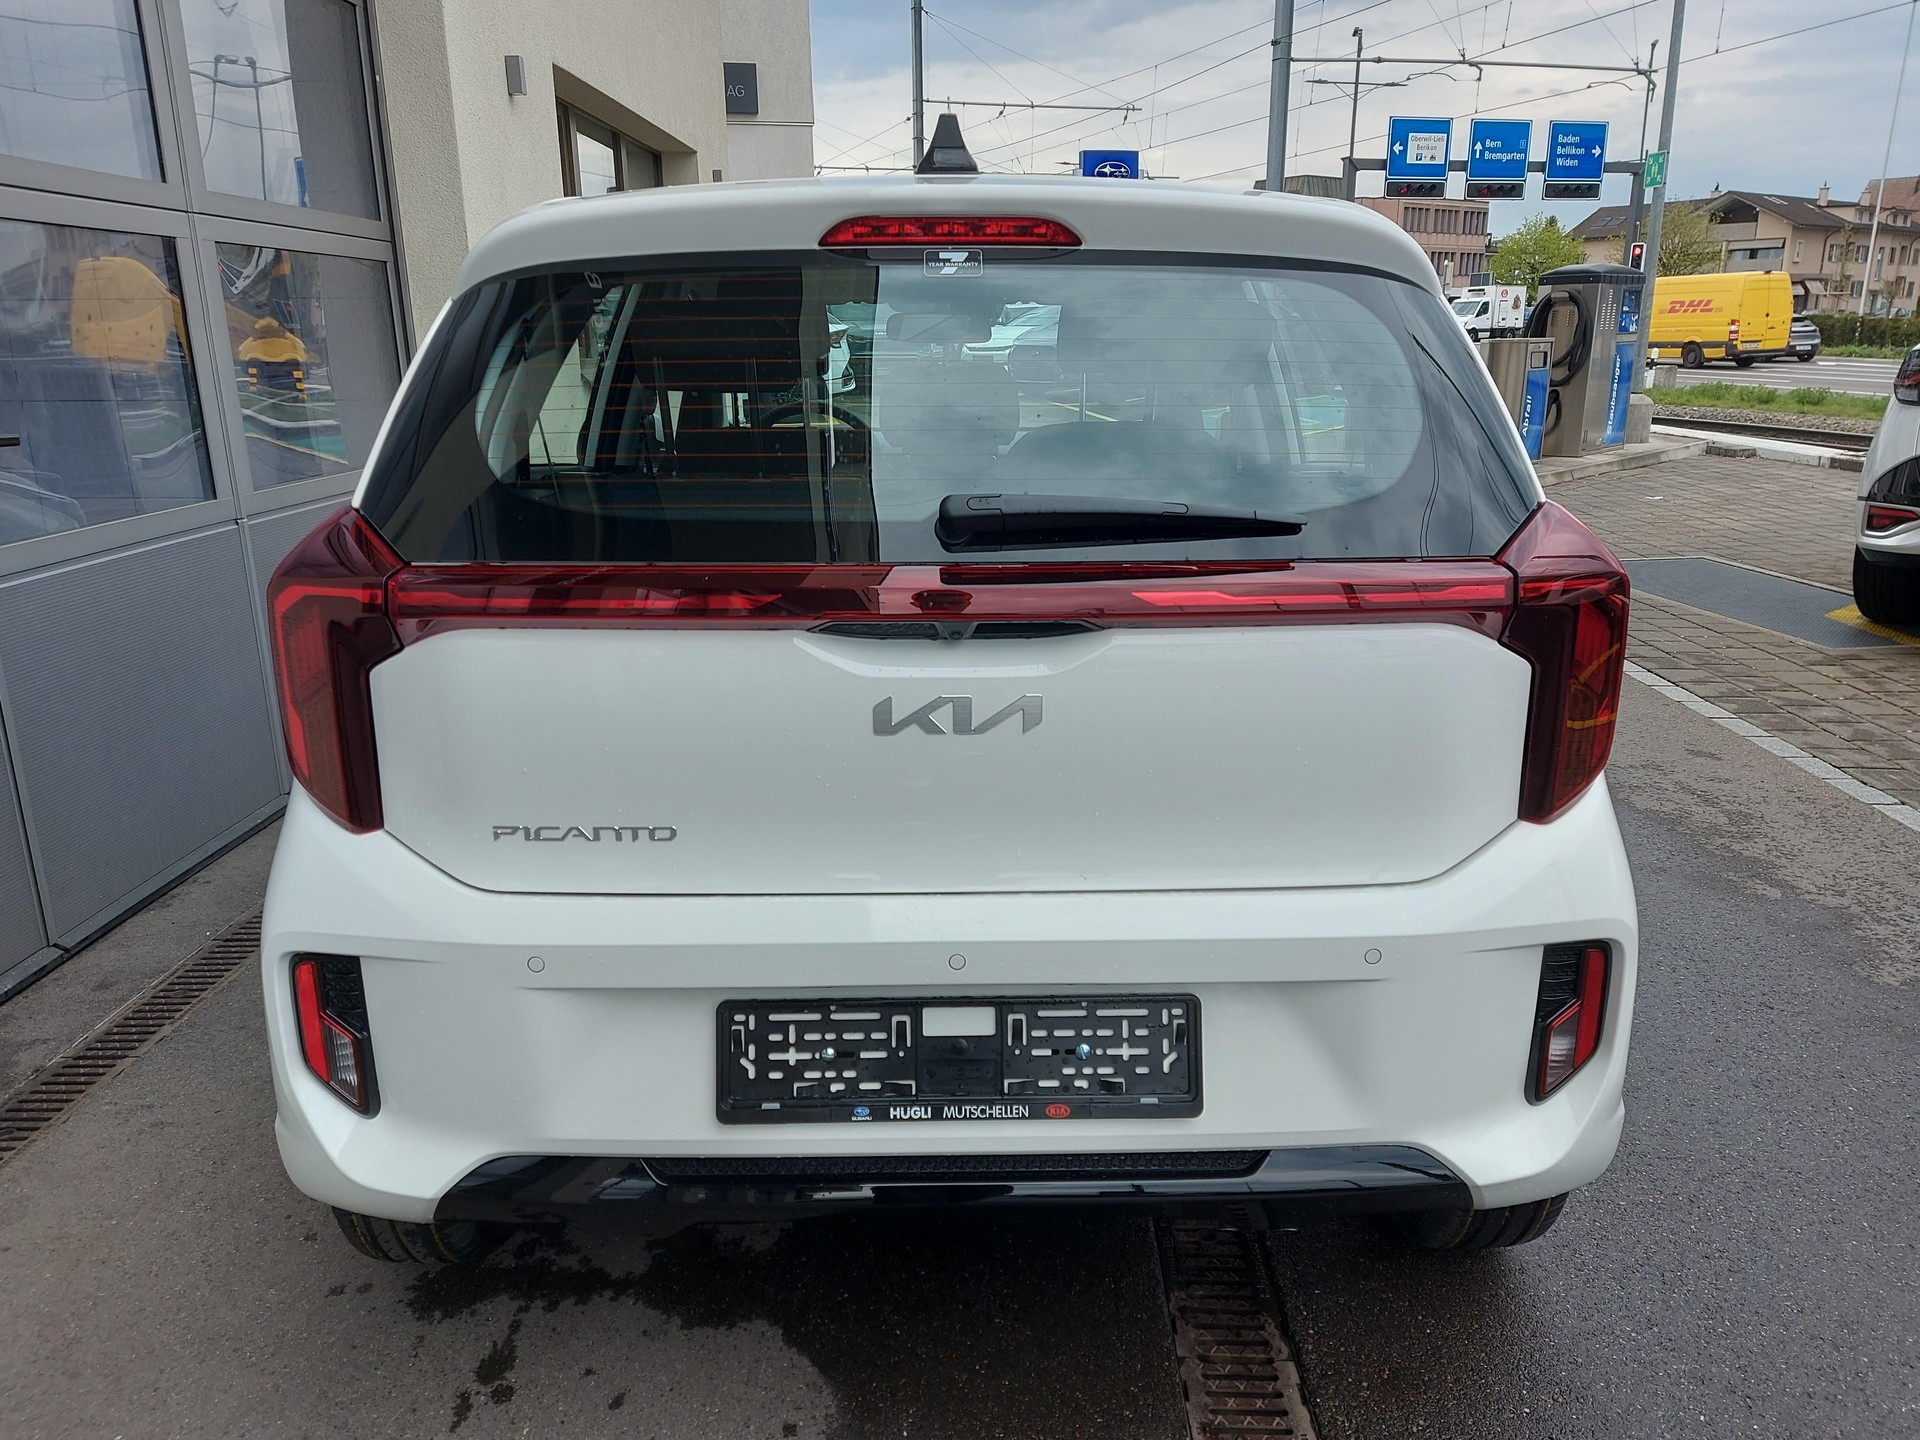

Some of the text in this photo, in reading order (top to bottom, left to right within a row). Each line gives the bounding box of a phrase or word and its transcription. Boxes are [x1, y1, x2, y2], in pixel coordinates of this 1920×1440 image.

[727, 84, 745, 97] AG
[1486, 139, 1502, 148] Bern
[1558, 134, 1580, 143] Baden
[1485, 151, 1525, 162] Bremgarten
[1557, 146, 1585, 155] Bellikon
[1556, 157, 1579, 167] Widen
[1667, 299, 1714, 314] DHL
[1607, 354, 1622, 435] Staubsauger
[1522, 395, 1532, 437] Abfall
[872, 693, 1044, 737] KIA
[492, 825, 678, 843] PICANTO
[889, 1106, 931, 1120] HÜGLI
[942, 1105, 1029, 1119] MUTSCHELLEN
